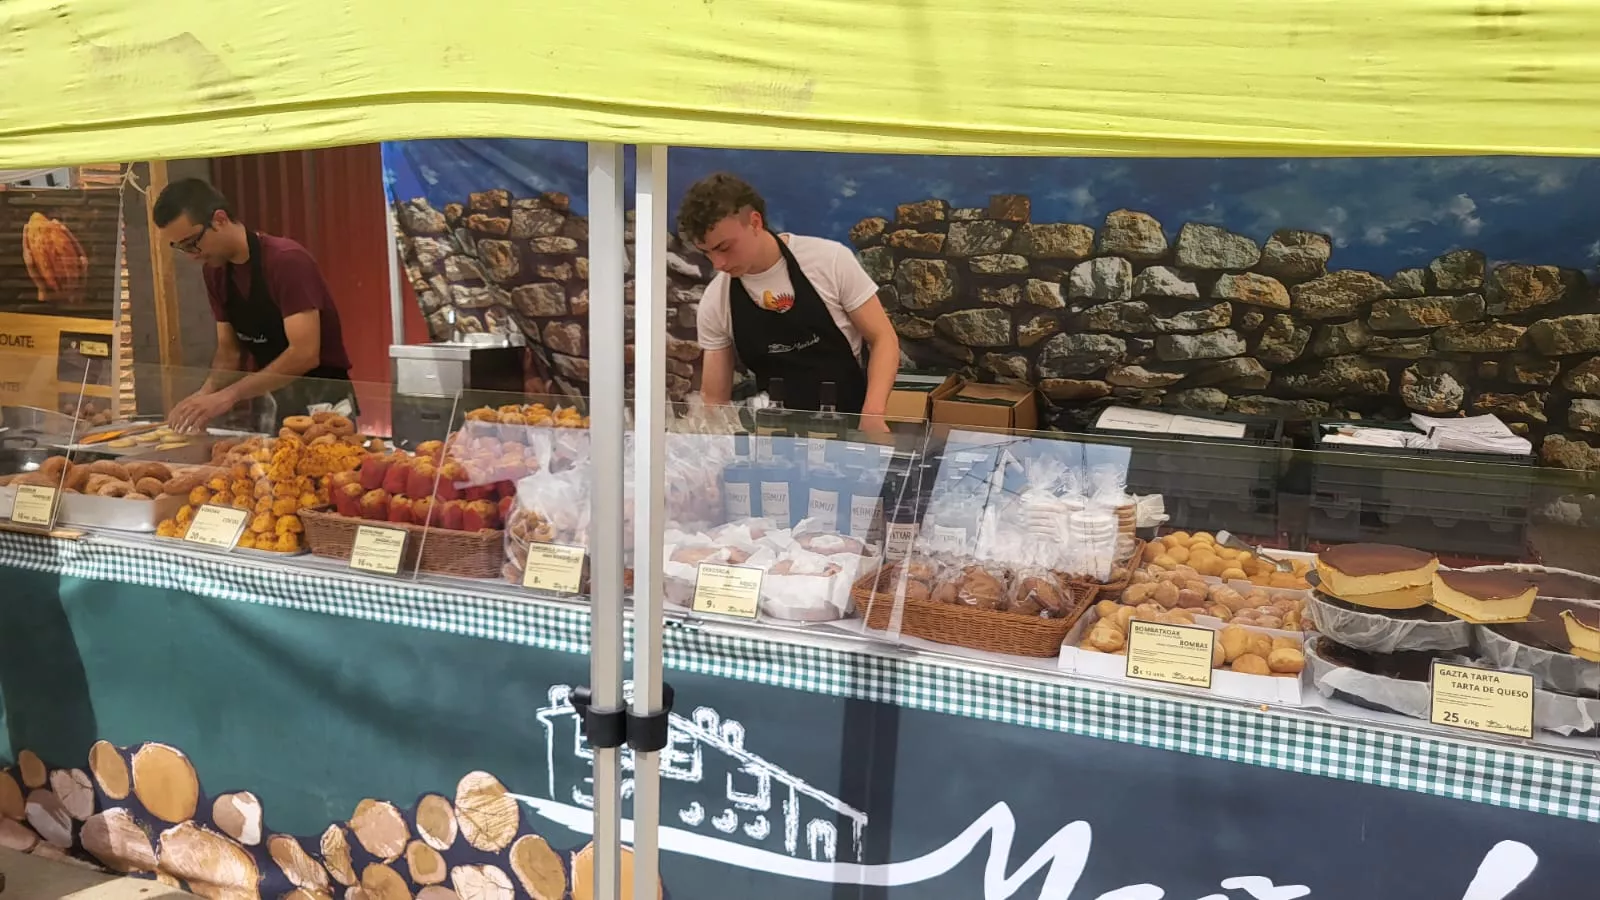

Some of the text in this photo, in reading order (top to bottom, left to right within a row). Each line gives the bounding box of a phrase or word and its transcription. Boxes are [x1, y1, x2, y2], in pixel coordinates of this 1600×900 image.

[1179, 640, 1208, 649] BOMBAS
[1439, 668, 1500, 683] GAZTA TARTA
[1451, 681, 1529, 699] TARTA DE QUESO
[1443, 711, 1459, 723] 25
